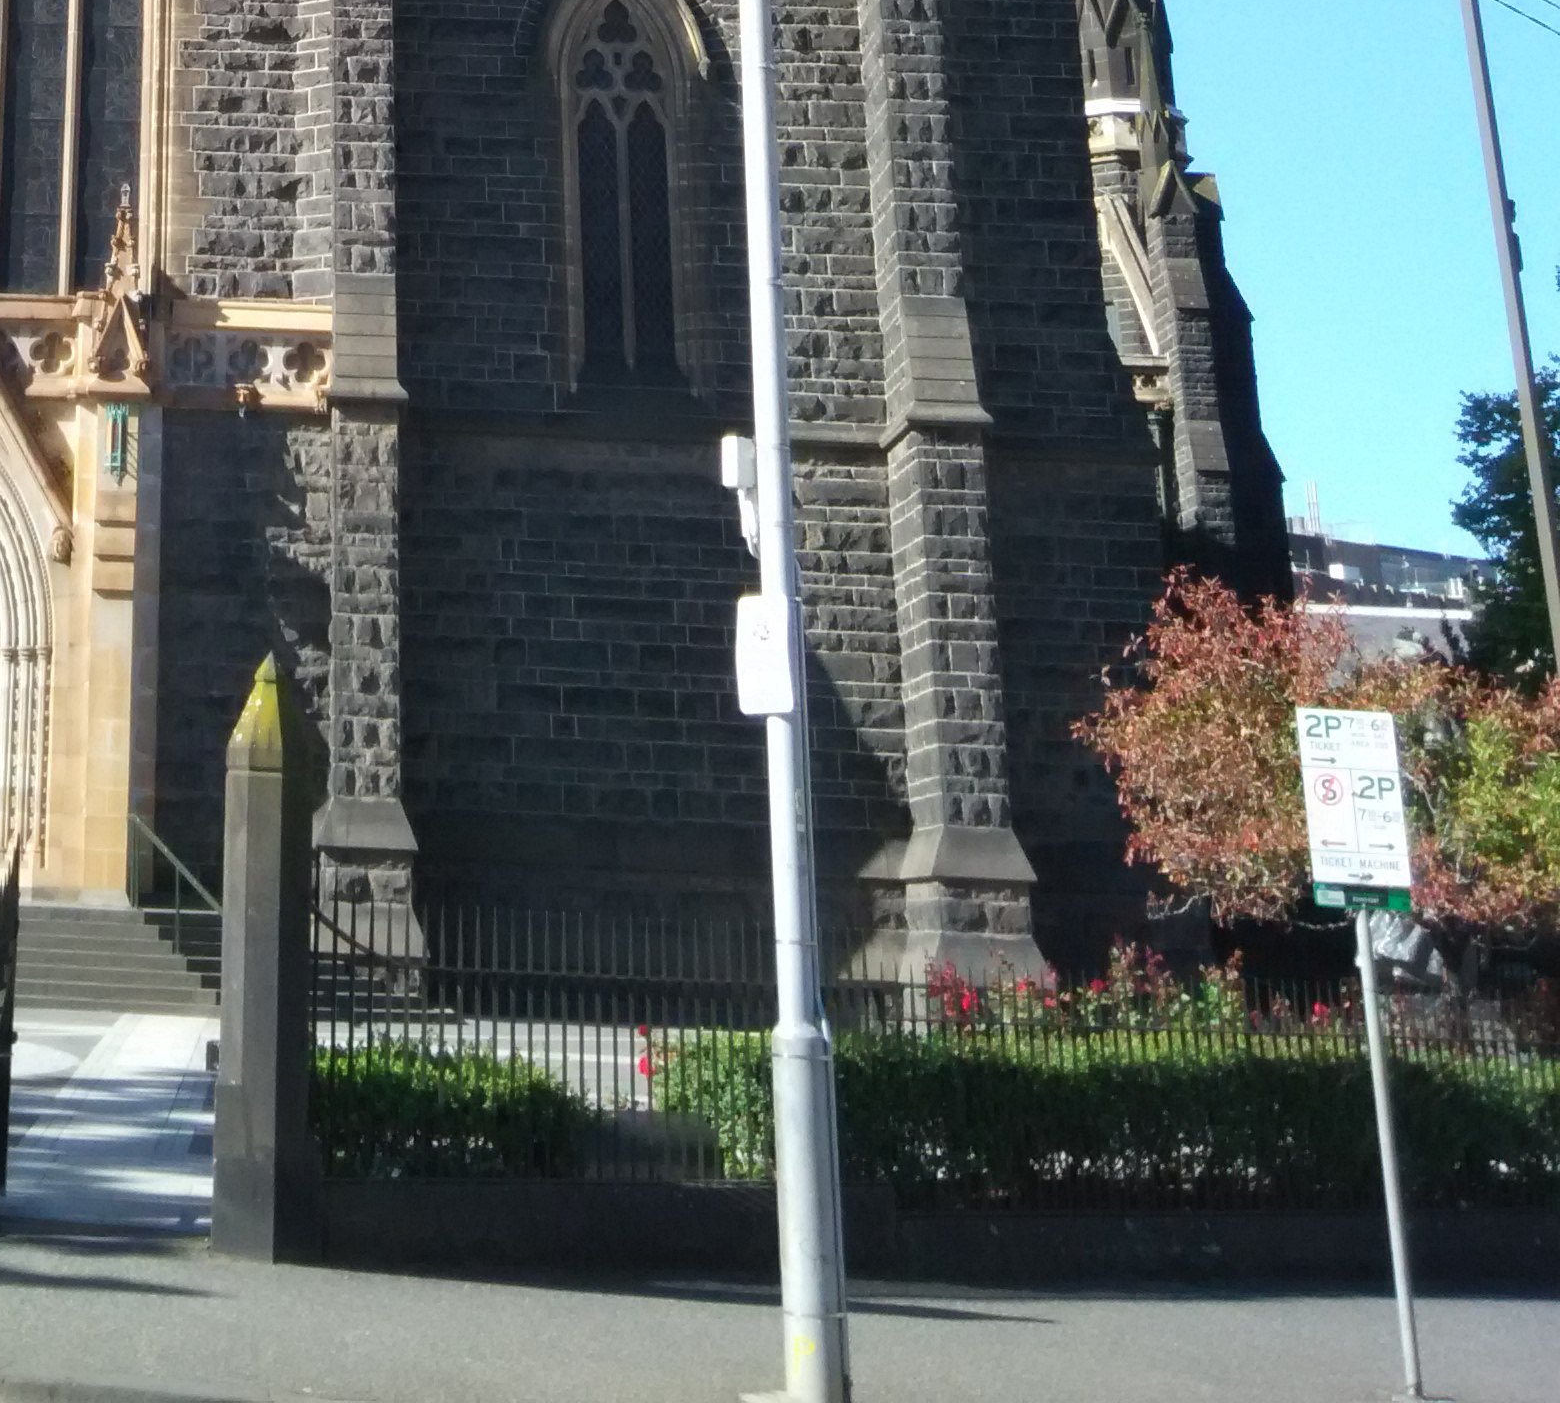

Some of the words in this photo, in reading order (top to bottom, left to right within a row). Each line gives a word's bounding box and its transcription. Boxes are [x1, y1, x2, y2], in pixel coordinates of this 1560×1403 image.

[1304, 713, 1342, 739] 2P
[1309, 740, 1341, 752] TICKET
[1357, 775, 1395, 800] 2P
[1320, 855, 1353, 868] TICKET
[1359, 857, 1401, 872] MACHINE
